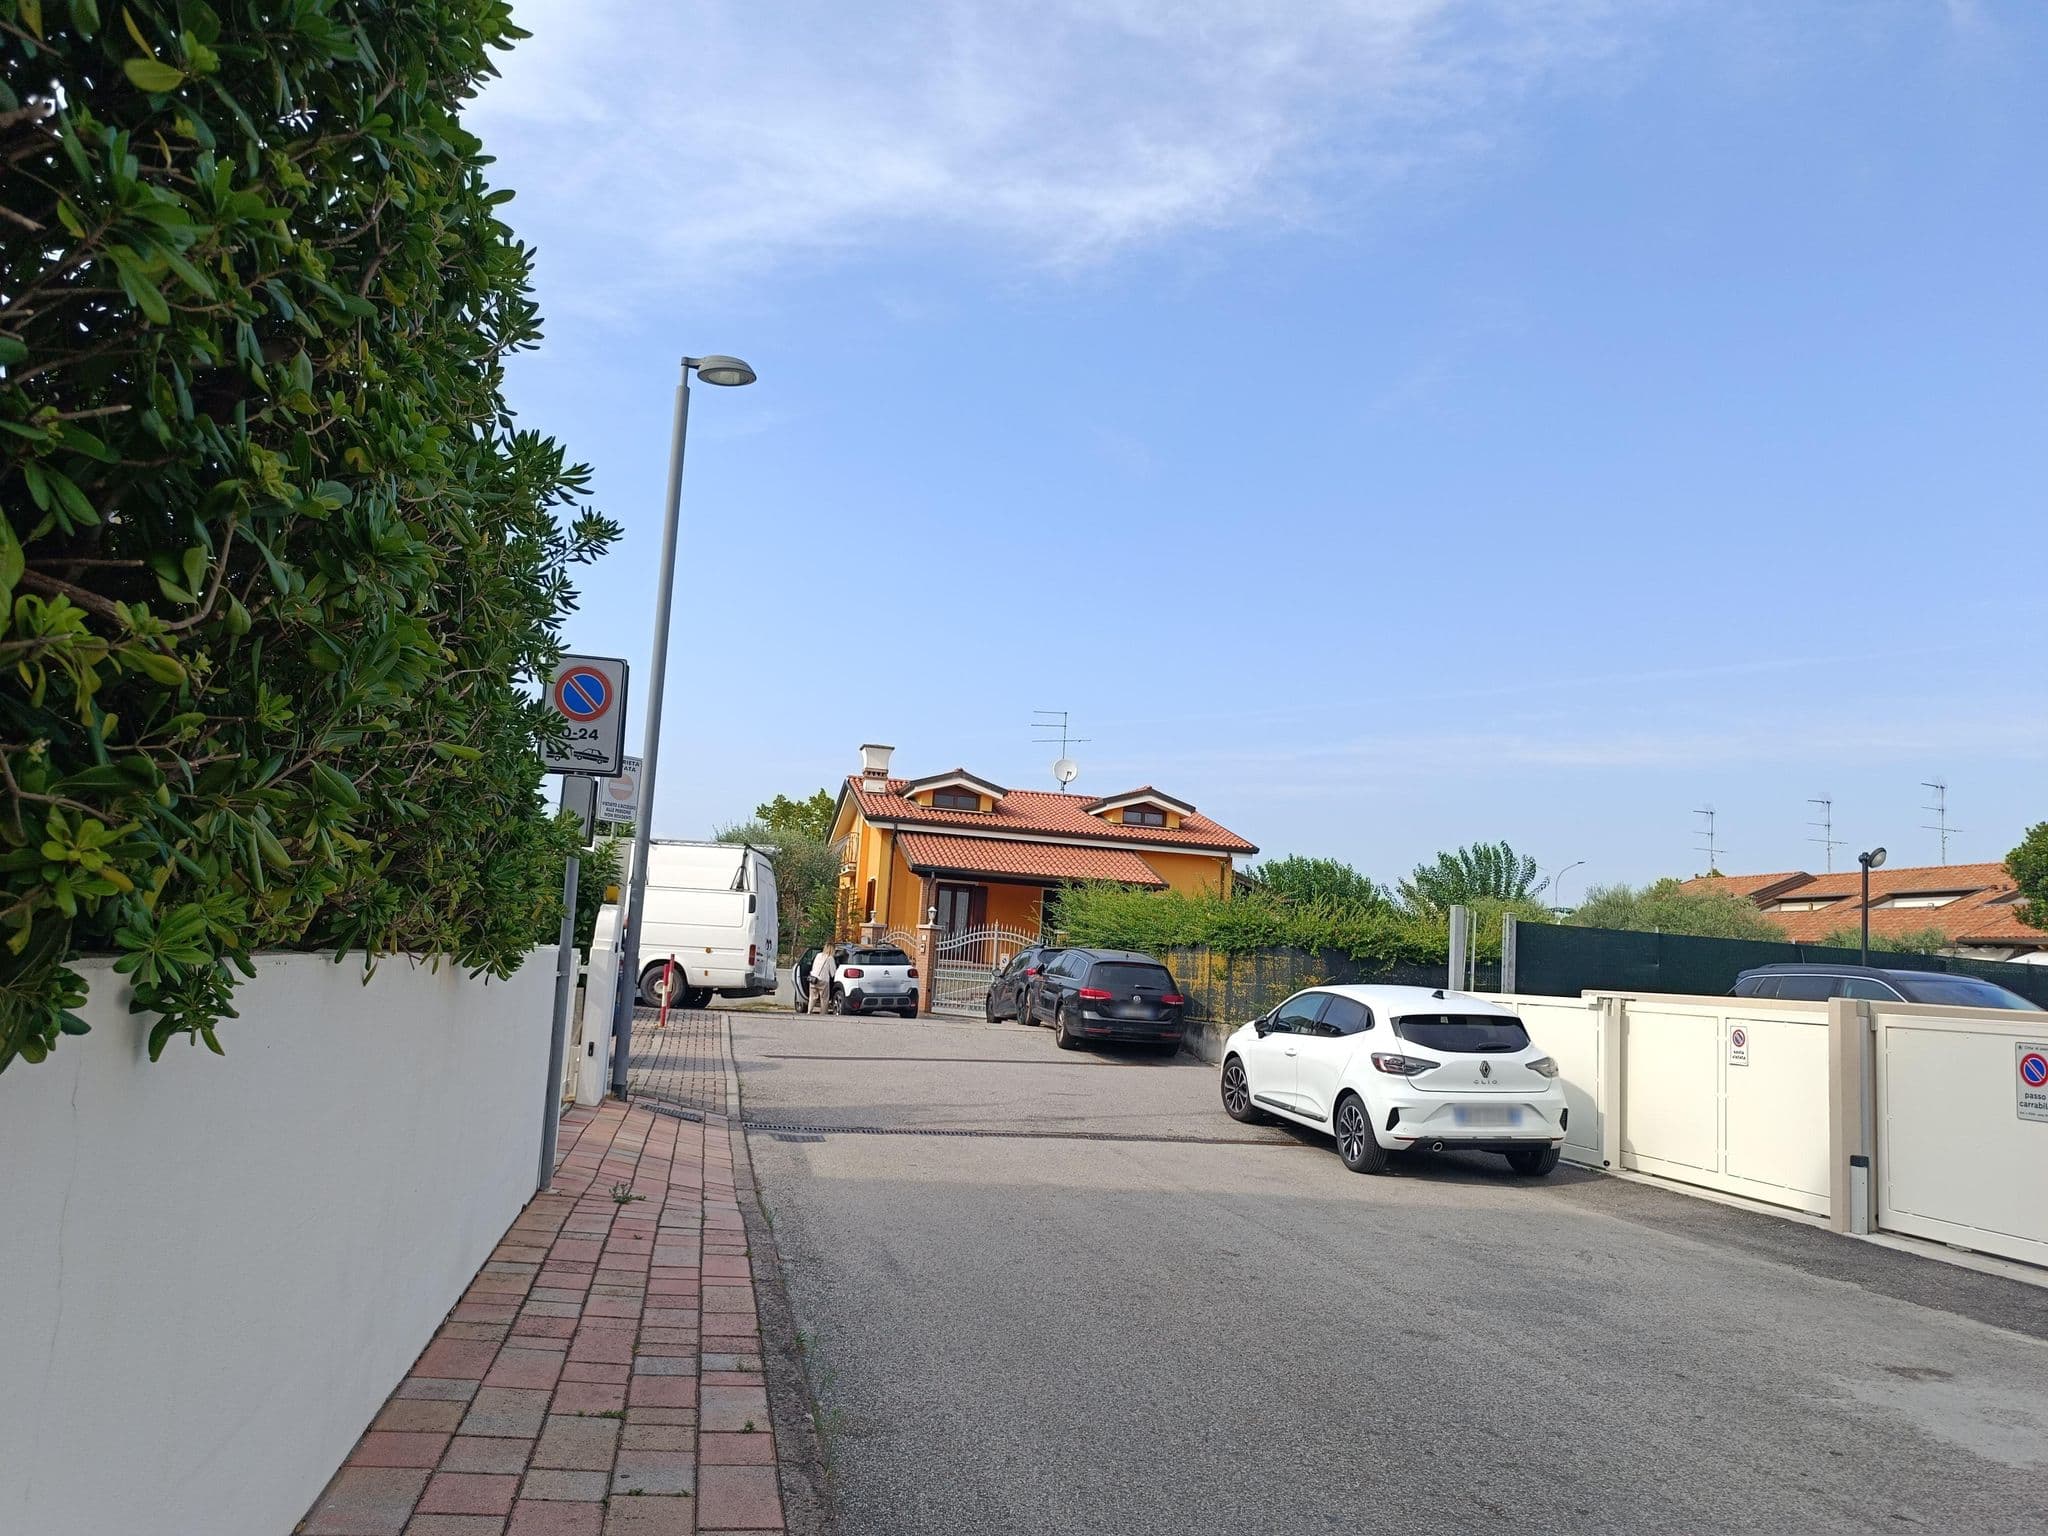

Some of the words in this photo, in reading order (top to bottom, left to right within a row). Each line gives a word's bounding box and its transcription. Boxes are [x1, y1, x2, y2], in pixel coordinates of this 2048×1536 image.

[562, 727, 598, 740] 0-24
[2025, 1093, 2046, 1101] passo
[2019, 1101, 2048, 1110] carrabil
